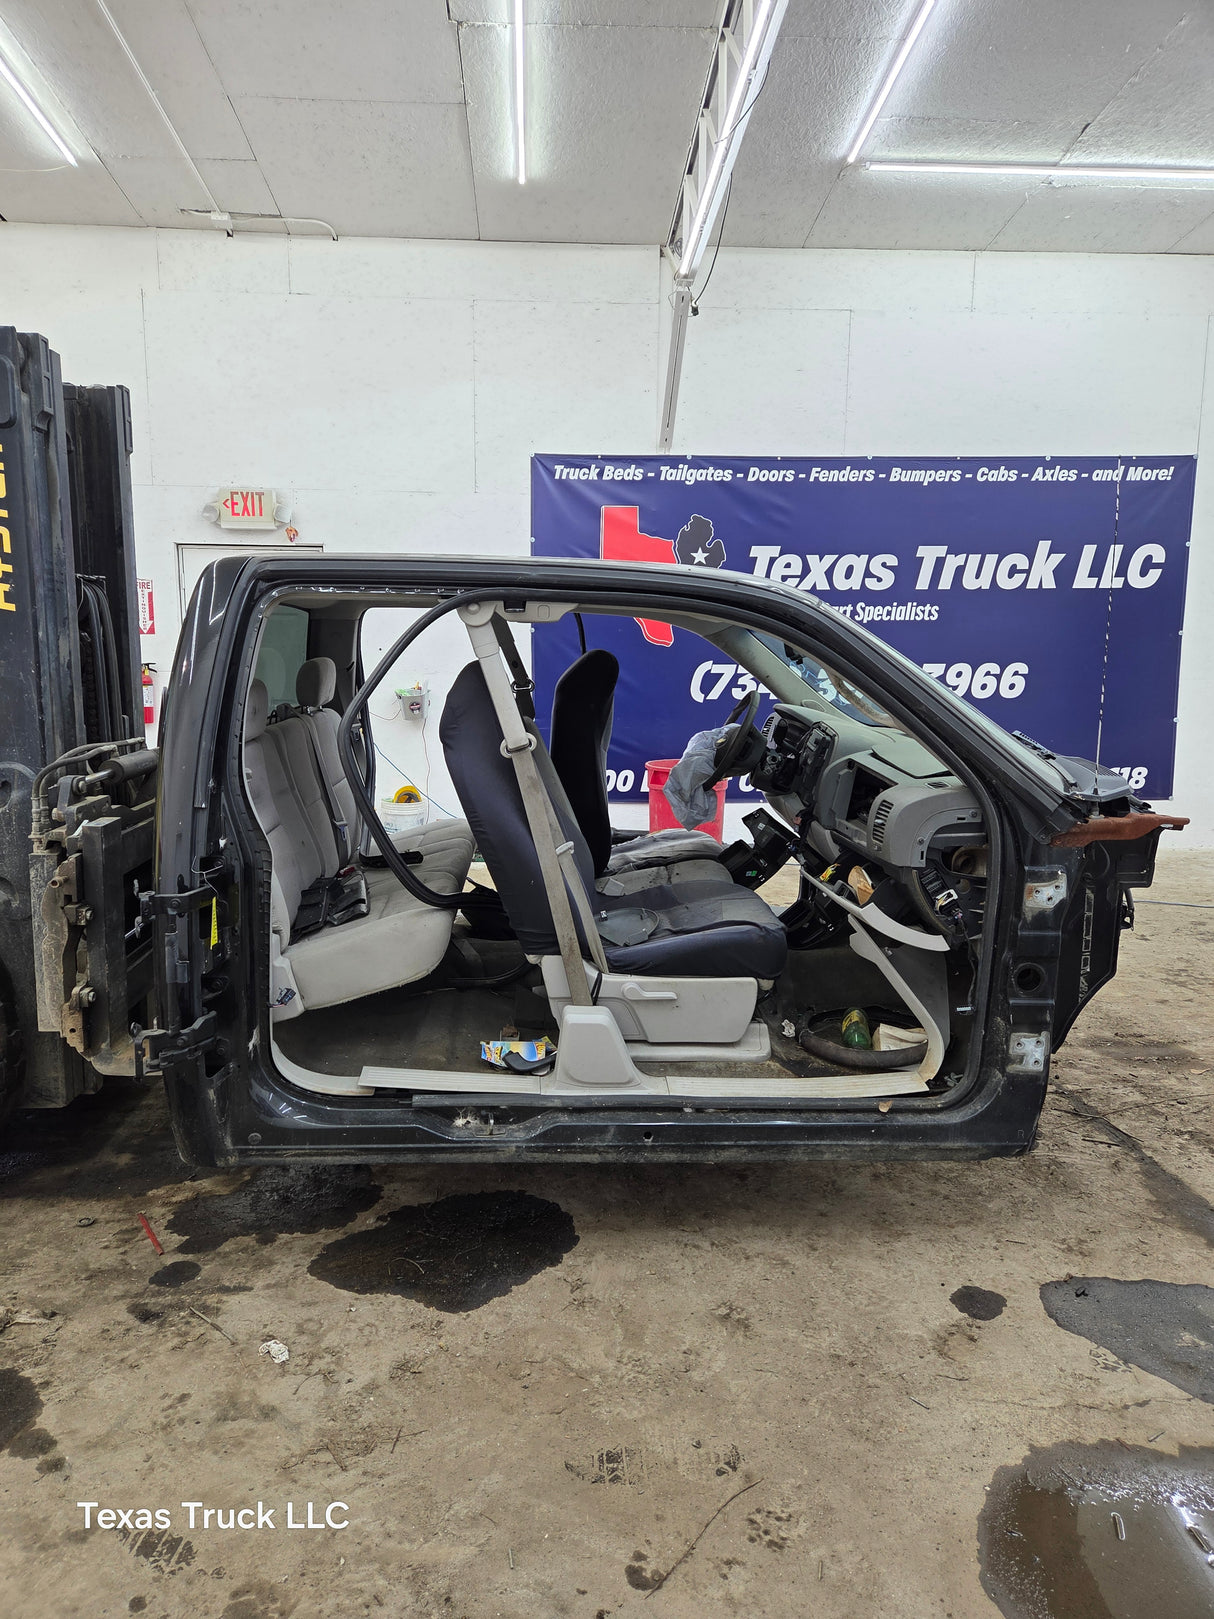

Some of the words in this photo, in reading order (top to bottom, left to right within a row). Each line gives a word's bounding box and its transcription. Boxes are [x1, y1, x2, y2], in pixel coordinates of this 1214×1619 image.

[554, 464, 600, 480] Truck
[602, 464, 644, 480] Beds
[659, 464, 733, 484] Tailgates
[747, 467, 795, 482] Doors
[809, 466, 875, 482] Fenders
[889, 467, 961, 485] Bumpers
[976, 466, 1018, 482] Cabs
[1031, 466, 1078, 482] Axles
[1092, 465, 1125, 481] and
[1126, 466, 1174, 481] More!
[230, 491, 265, 518] EXIT
[750, 545, 899, 591] Texas
[915, 540, 1066, 590] Truck
[1072, 543, 1166, 589] LLC
[854, 602, 940, 624] Specialists
